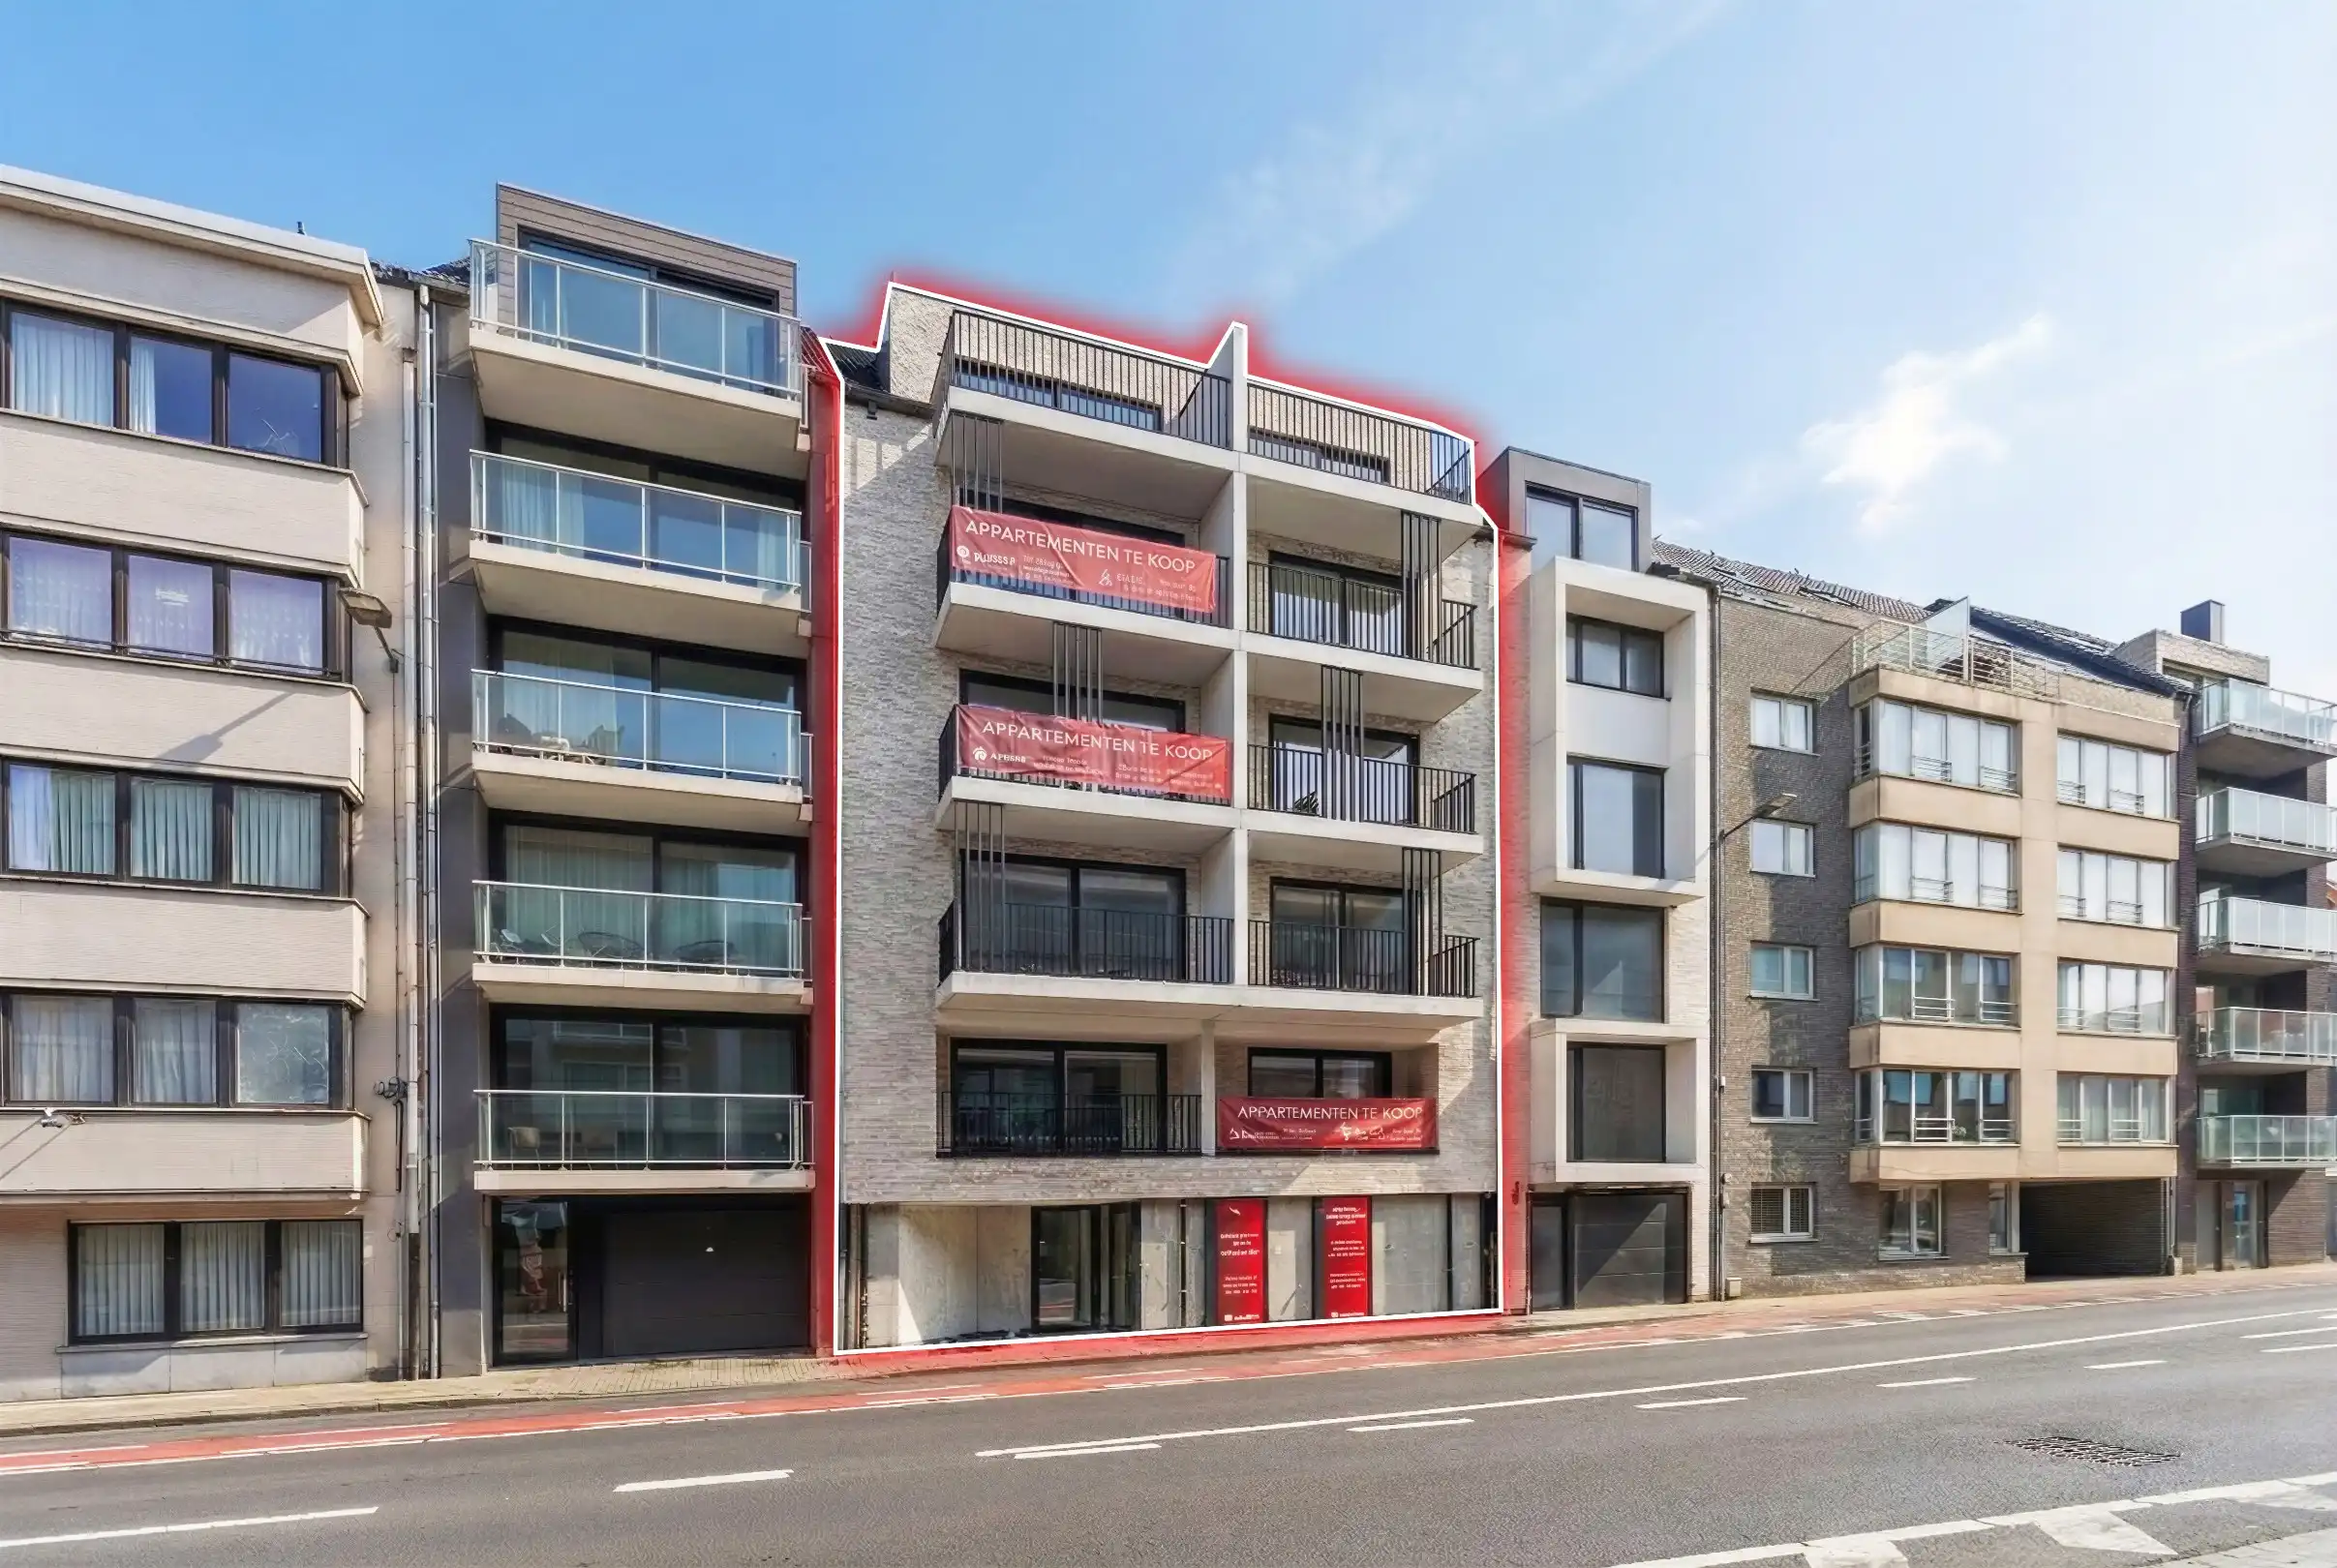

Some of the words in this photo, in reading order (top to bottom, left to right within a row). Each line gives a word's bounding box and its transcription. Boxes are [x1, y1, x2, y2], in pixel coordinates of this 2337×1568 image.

[965, 520, 1119, 560] APPARTEMENTEN
[1125, 548, 1142, 564] TE
[1148, 554, 1196, 573] KOOP
[983, 721, 1135, 752] APPARTEMENTEN
[1139, 741, 1160, 755] TE
[1165, 744, 1213, 760] KOOP
[1237, 1105, 1358, 1119] APPARTEMENTEN
[1362, 1107, 1378, 1120] TE
[1382, 1107, 1423, 1119] KOOP
